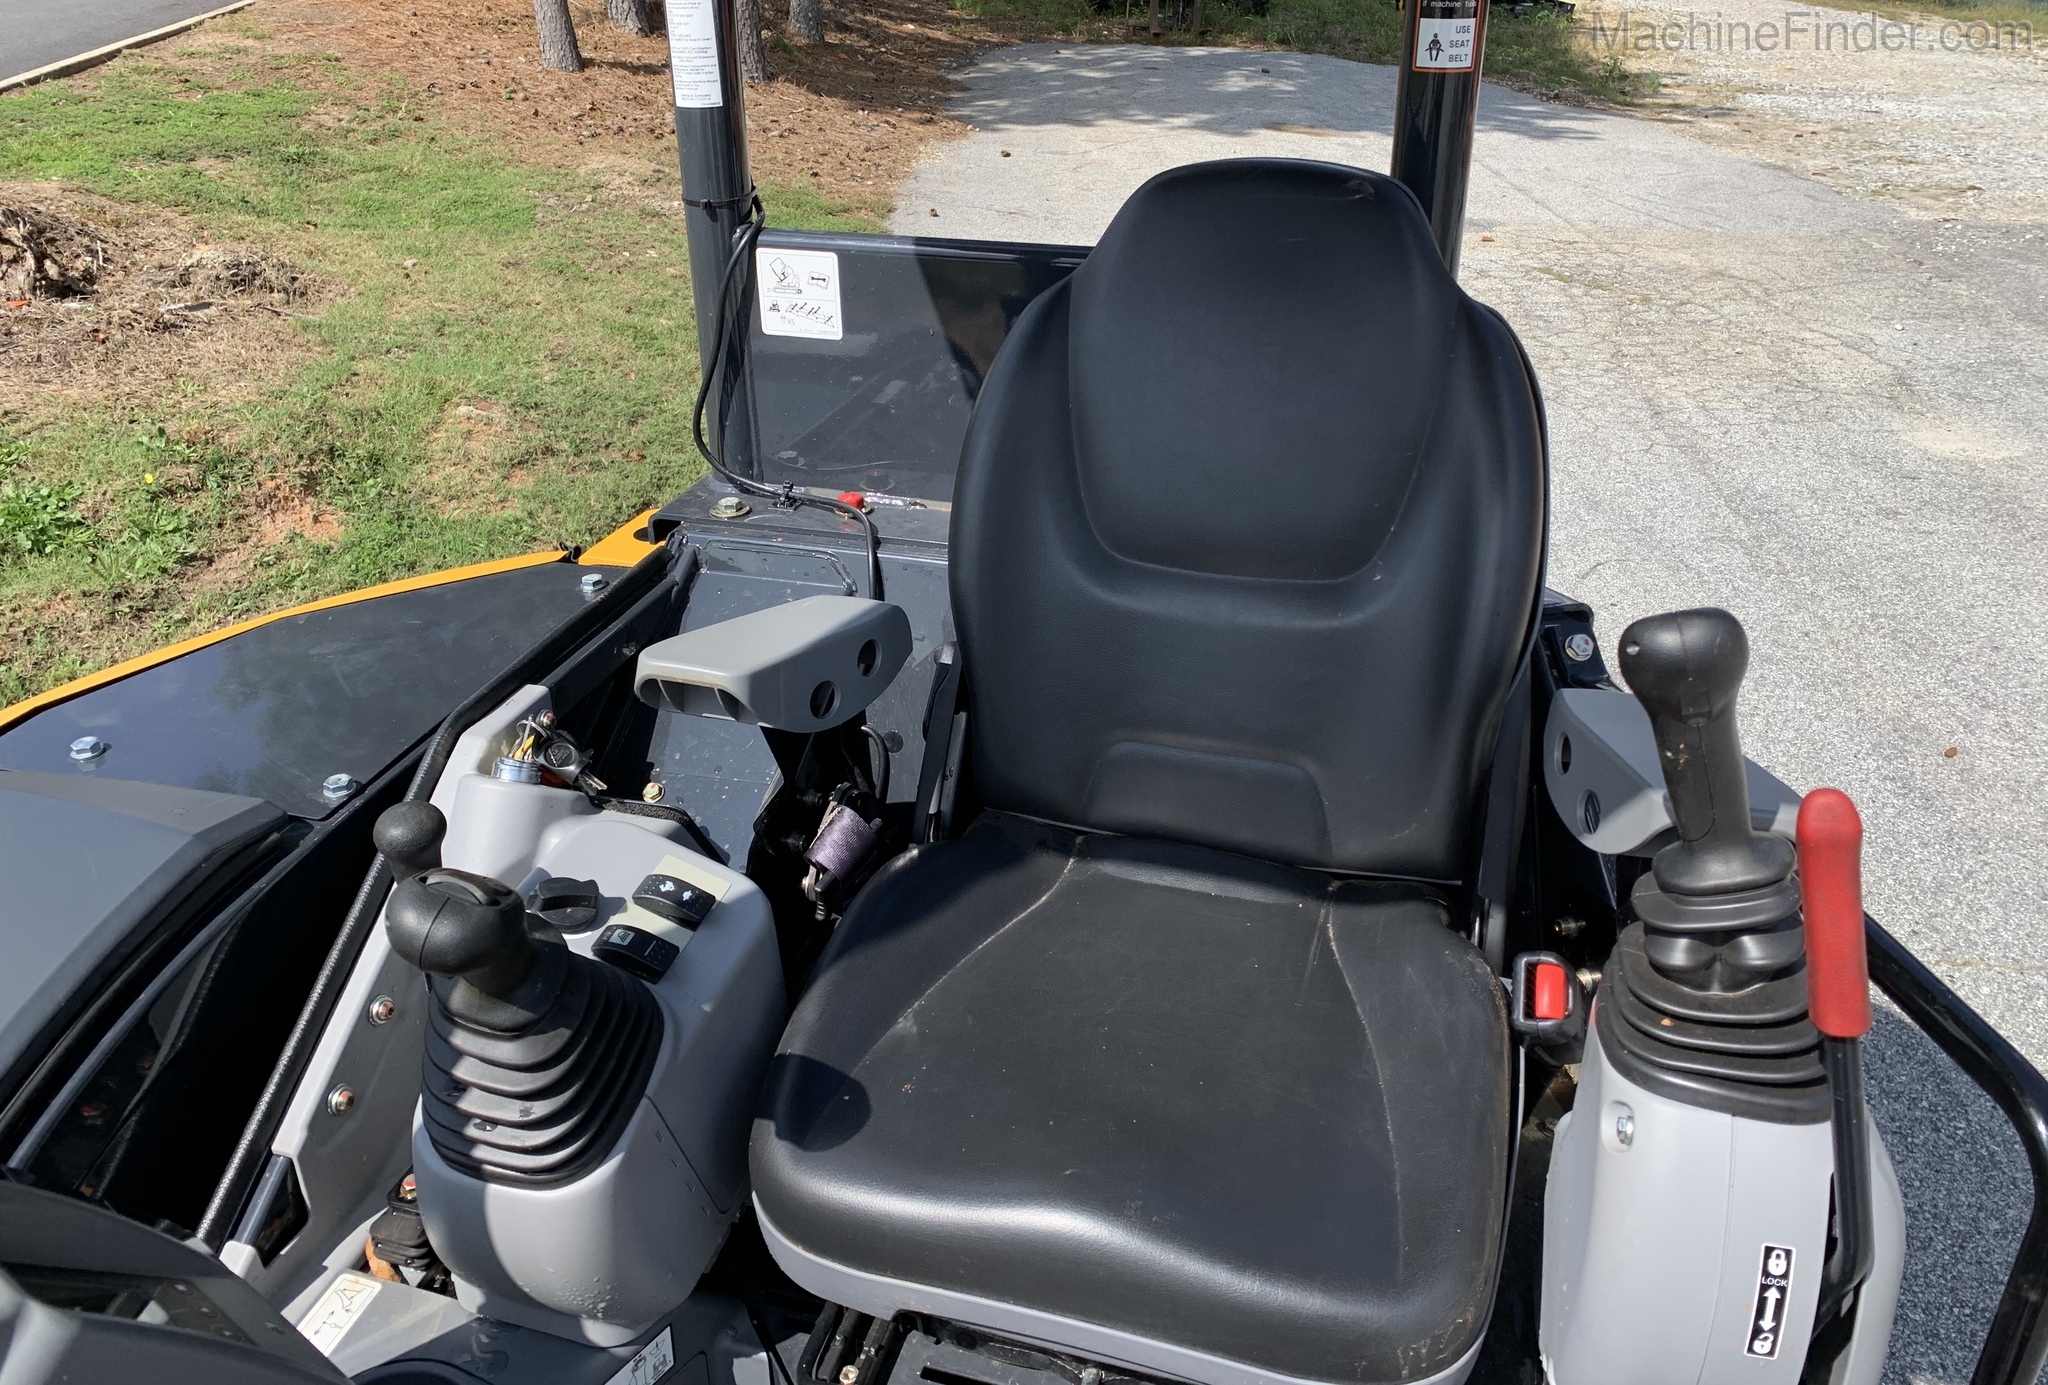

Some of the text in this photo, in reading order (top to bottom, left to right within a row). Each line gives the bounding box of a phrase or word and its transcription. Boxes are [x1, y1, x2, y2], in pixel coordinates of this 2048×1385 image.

[1455, 25, 1471, 34] USE
[1448, 40, 1470, 48] SEAT
[1448, 54, 1469, 62] BELT
[1761, 1276, 1788, 1287] LOCK
